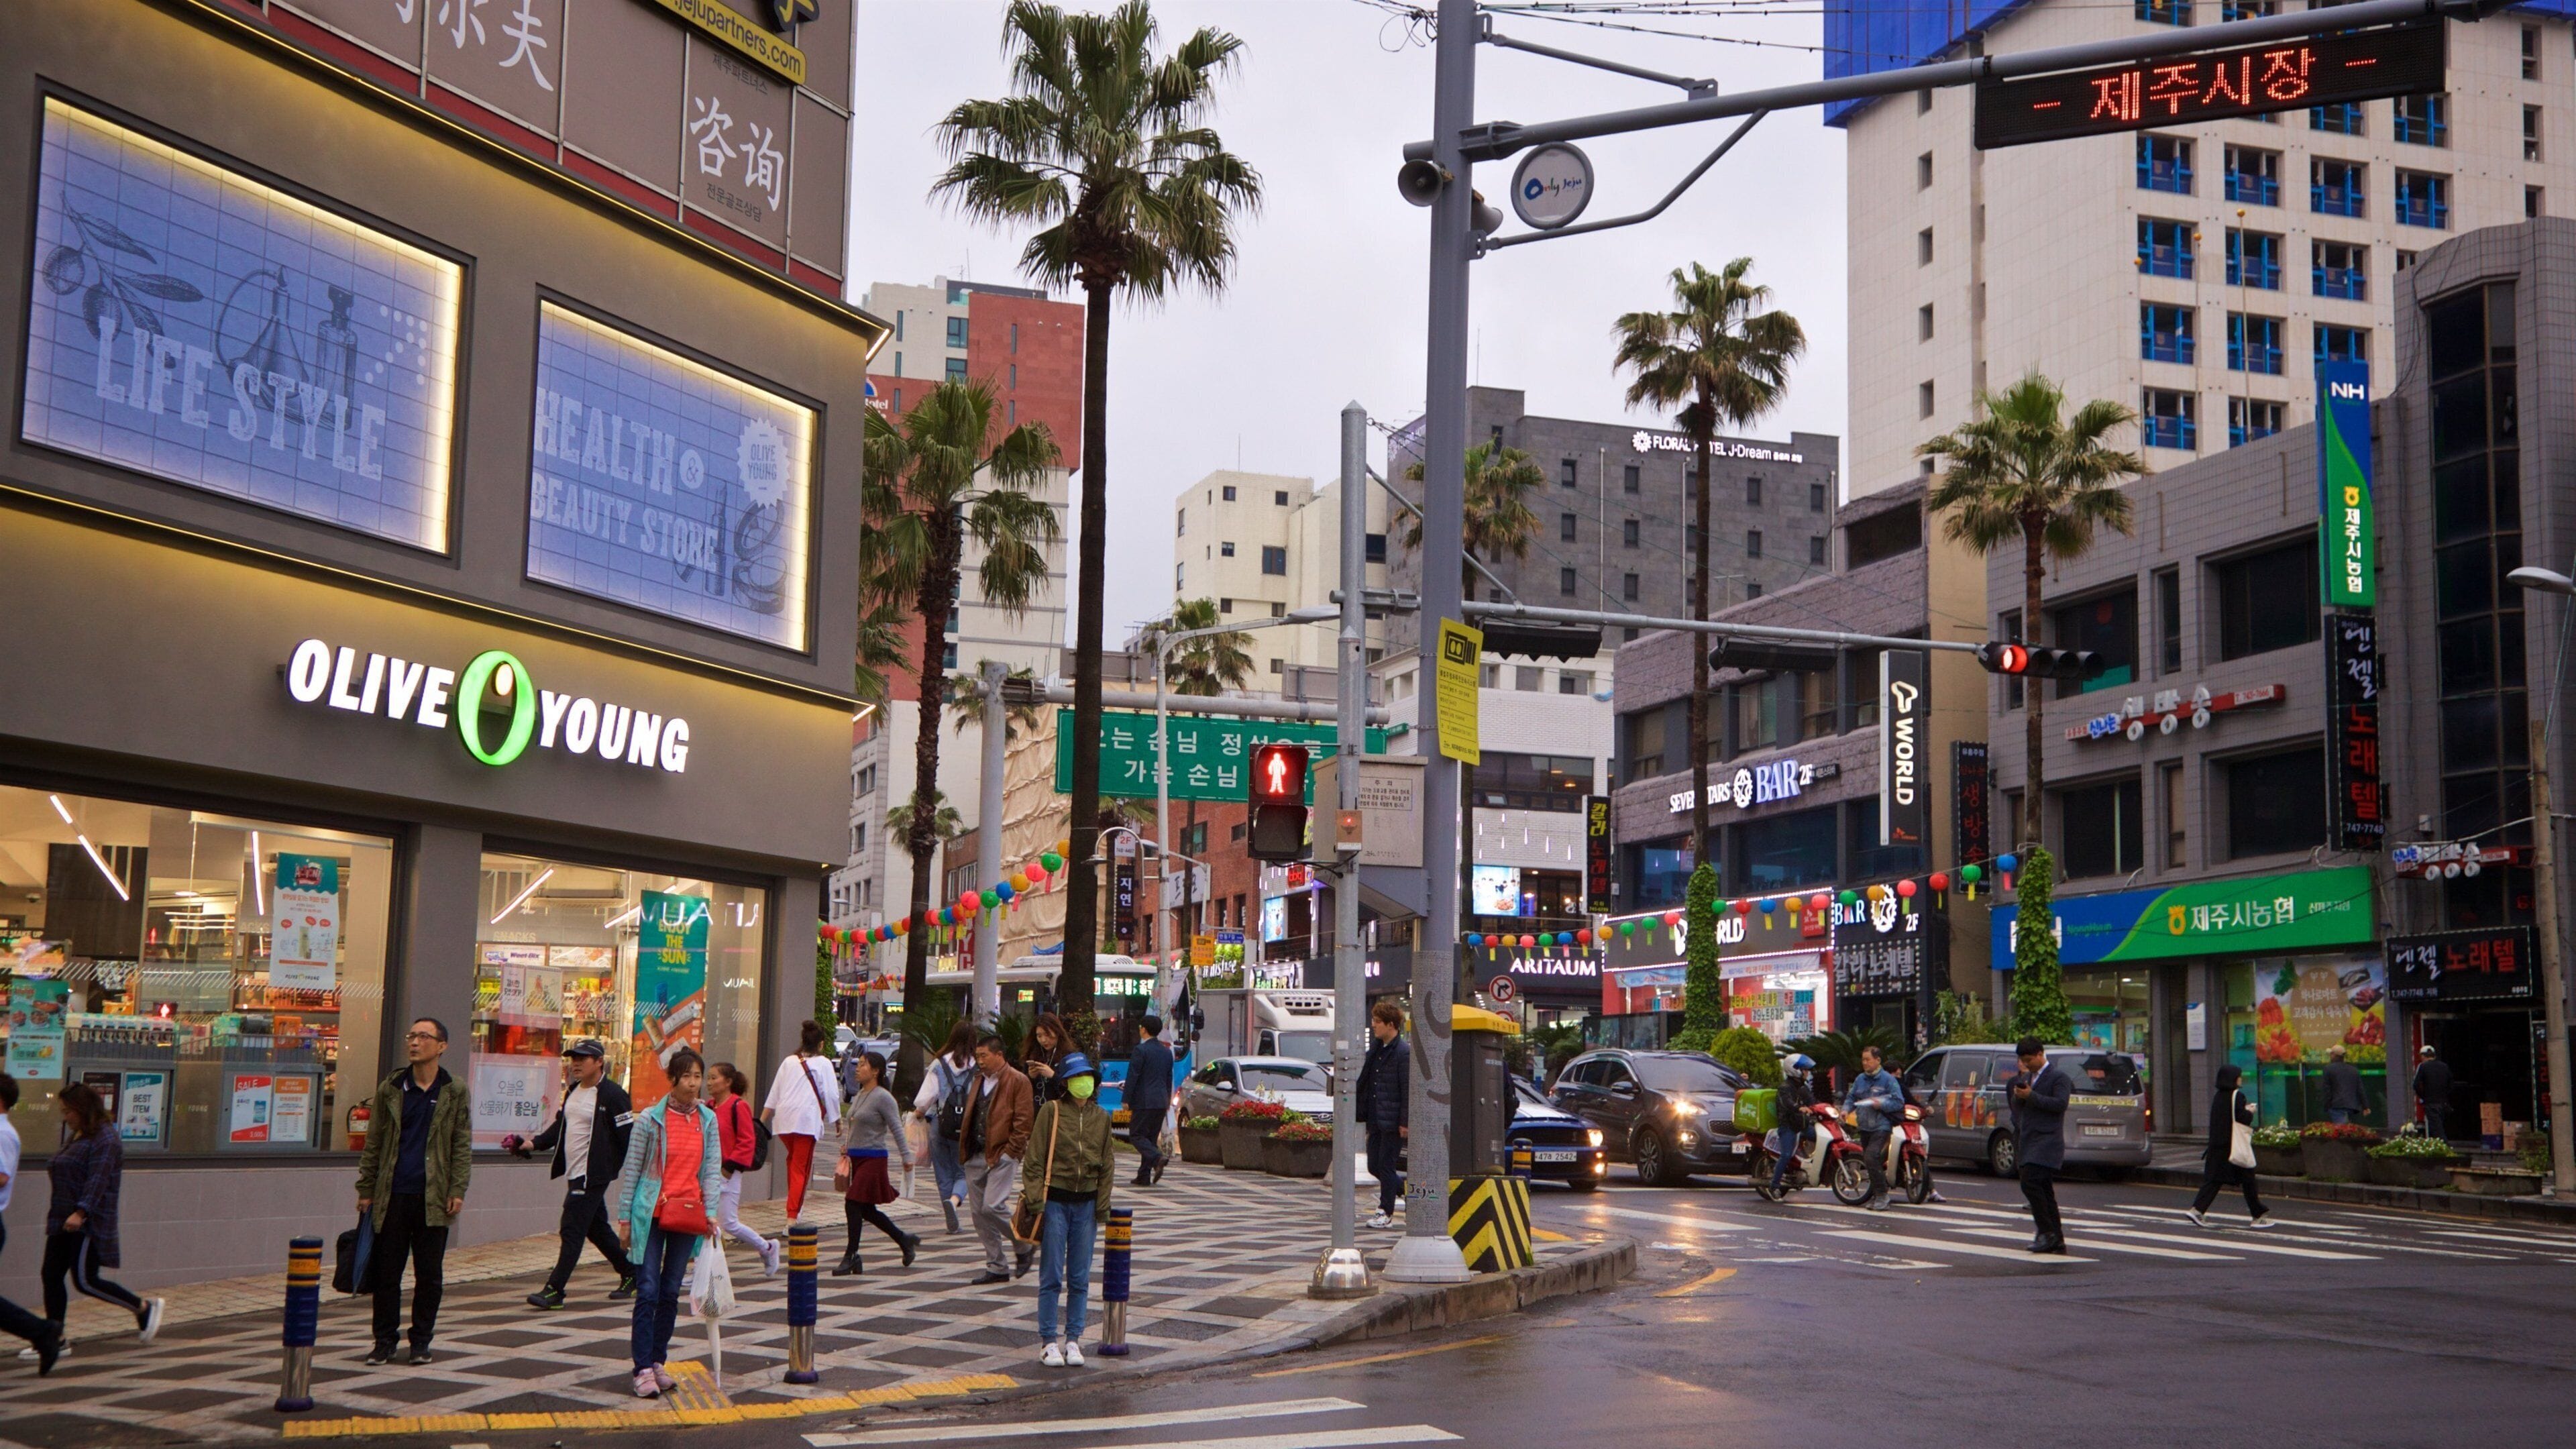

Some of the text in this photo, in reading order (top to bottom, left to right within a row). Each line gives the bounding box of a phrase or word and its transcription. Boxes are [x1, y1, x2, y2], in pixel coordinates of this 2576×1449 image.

[713, 54, 768, 94] 제주파트너스
[2090, 48, 2316, 121] 제주시장
[690, 96, 784, 212] 咨询
[707, 182, 761, 222] 전문골프상담
[96, 315, 386, 480] LIFE STYLE
[2331, 382, 2364, 400] NH
[535, 387, 676, 495] HEALTH
[751, 443, 776, 463] OLIVE
[747, 462, 777, 481] YOUNG
[531, 471, 720, 572] BEAUTY STORE
[2344, 508, 2363, 594] 제주시농협
[2345, 626, 2377, 700] 엔젤
[286, 639, 690, 773] OLIVE YOUNG
[1895, 718, 1914, 805] WORLD
[2349, 704, 2377, 819] 노래텔
[1187, 763, 1237, 788] 손님
[1707, 782, 1731, 805] TARS
[1756, 759, 1802, 804] BAR
[1799, 763, 1814, 786] 2F
[1906, 913, 1919, 932] 2F
[2190, 896, 2294, 931] 제주시농협
[493, 931, 536, 943] SNACKS
[658, 919, 691, 935] ENJOY
[1716, 918, 1746, 945] RLD
[665, 934, 684, 949] THE
[661, 949, 688, 965] SUN
[1510, 957, 1597, 977] ARITAUM
[2396, 939, 2516, 981] 엔젤 노래텔
[237, 1079, 259, 1090] SALE
[496, 1080, 526, 1096] 오늘은
[133, 1094, 152, 1103] BEST
[477, 1100, 513, 1116] 선물하기
[1556, 1152, 1573, 1161] 2542
[1409, 1183, 1435, 1199] Jeju
